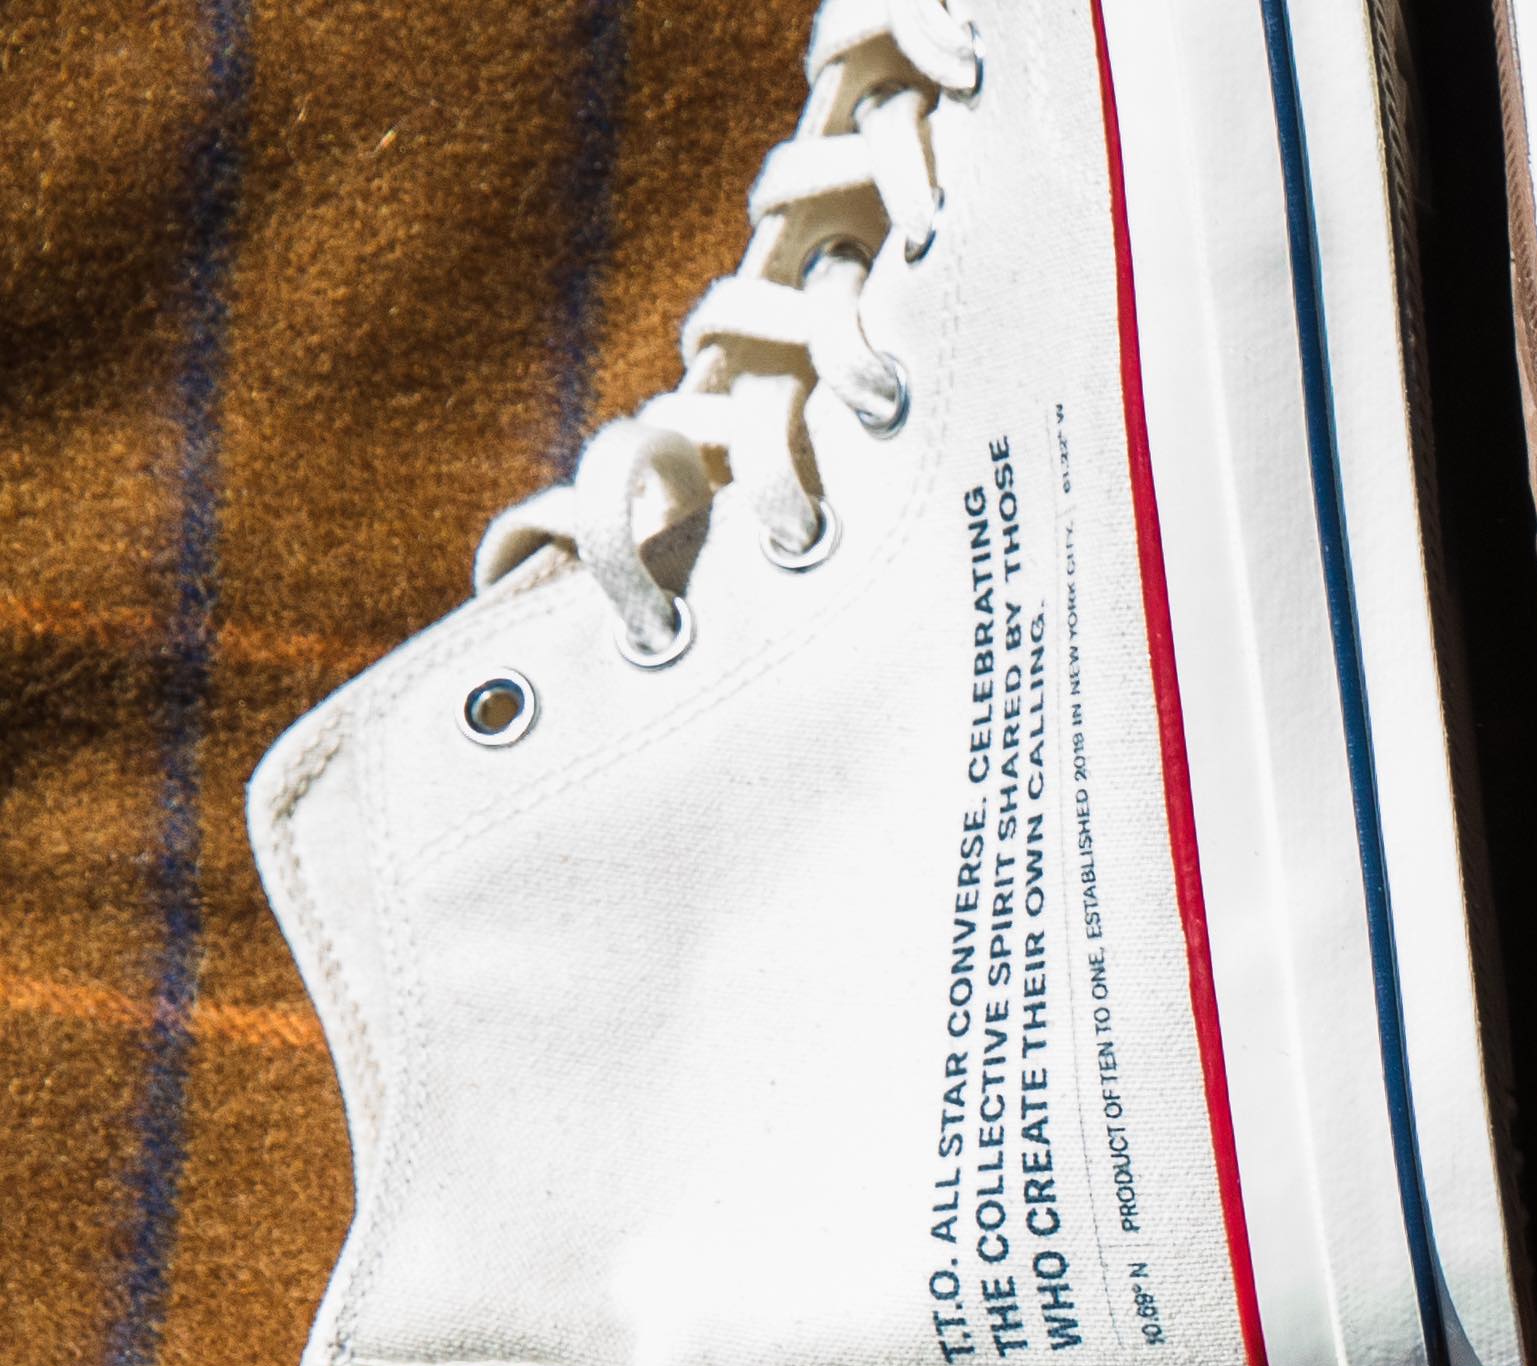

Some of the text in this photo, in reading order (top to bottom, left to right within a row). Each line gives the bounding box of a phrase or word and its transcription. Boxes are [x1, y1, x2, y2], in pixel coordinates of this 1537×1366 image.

[1055, 403, 1065, 424] W
[1067, 583, 1078, 640] YORK
[1069, 645, 1081, 696] NEW
[1071, 703, 1083, 726] IN
[1073, 732, 1087, 782] 2019
[1075, 788, 1103, 939] ESTABLISHED
[976, 435, 1029, 1359] THE COLLECTIVE SPIRIT SHARED BY THOSE
[929, 486, 994, 1366] T.T.O. ALL STAR CONVERSE. CELEBRATING
[1021, 599, 1083, 1351] WHO CREATE THEIR OWN CALLING.
[1094, 1008, 1111, 1033] TO
[1098, 1042, 1117, 1085] TEN
[1102, 1089, 1123, 1119] OF
[1106, 1125, 1141, 1233] PRODUCT
[1127, 1262, 1149, 1278] N
